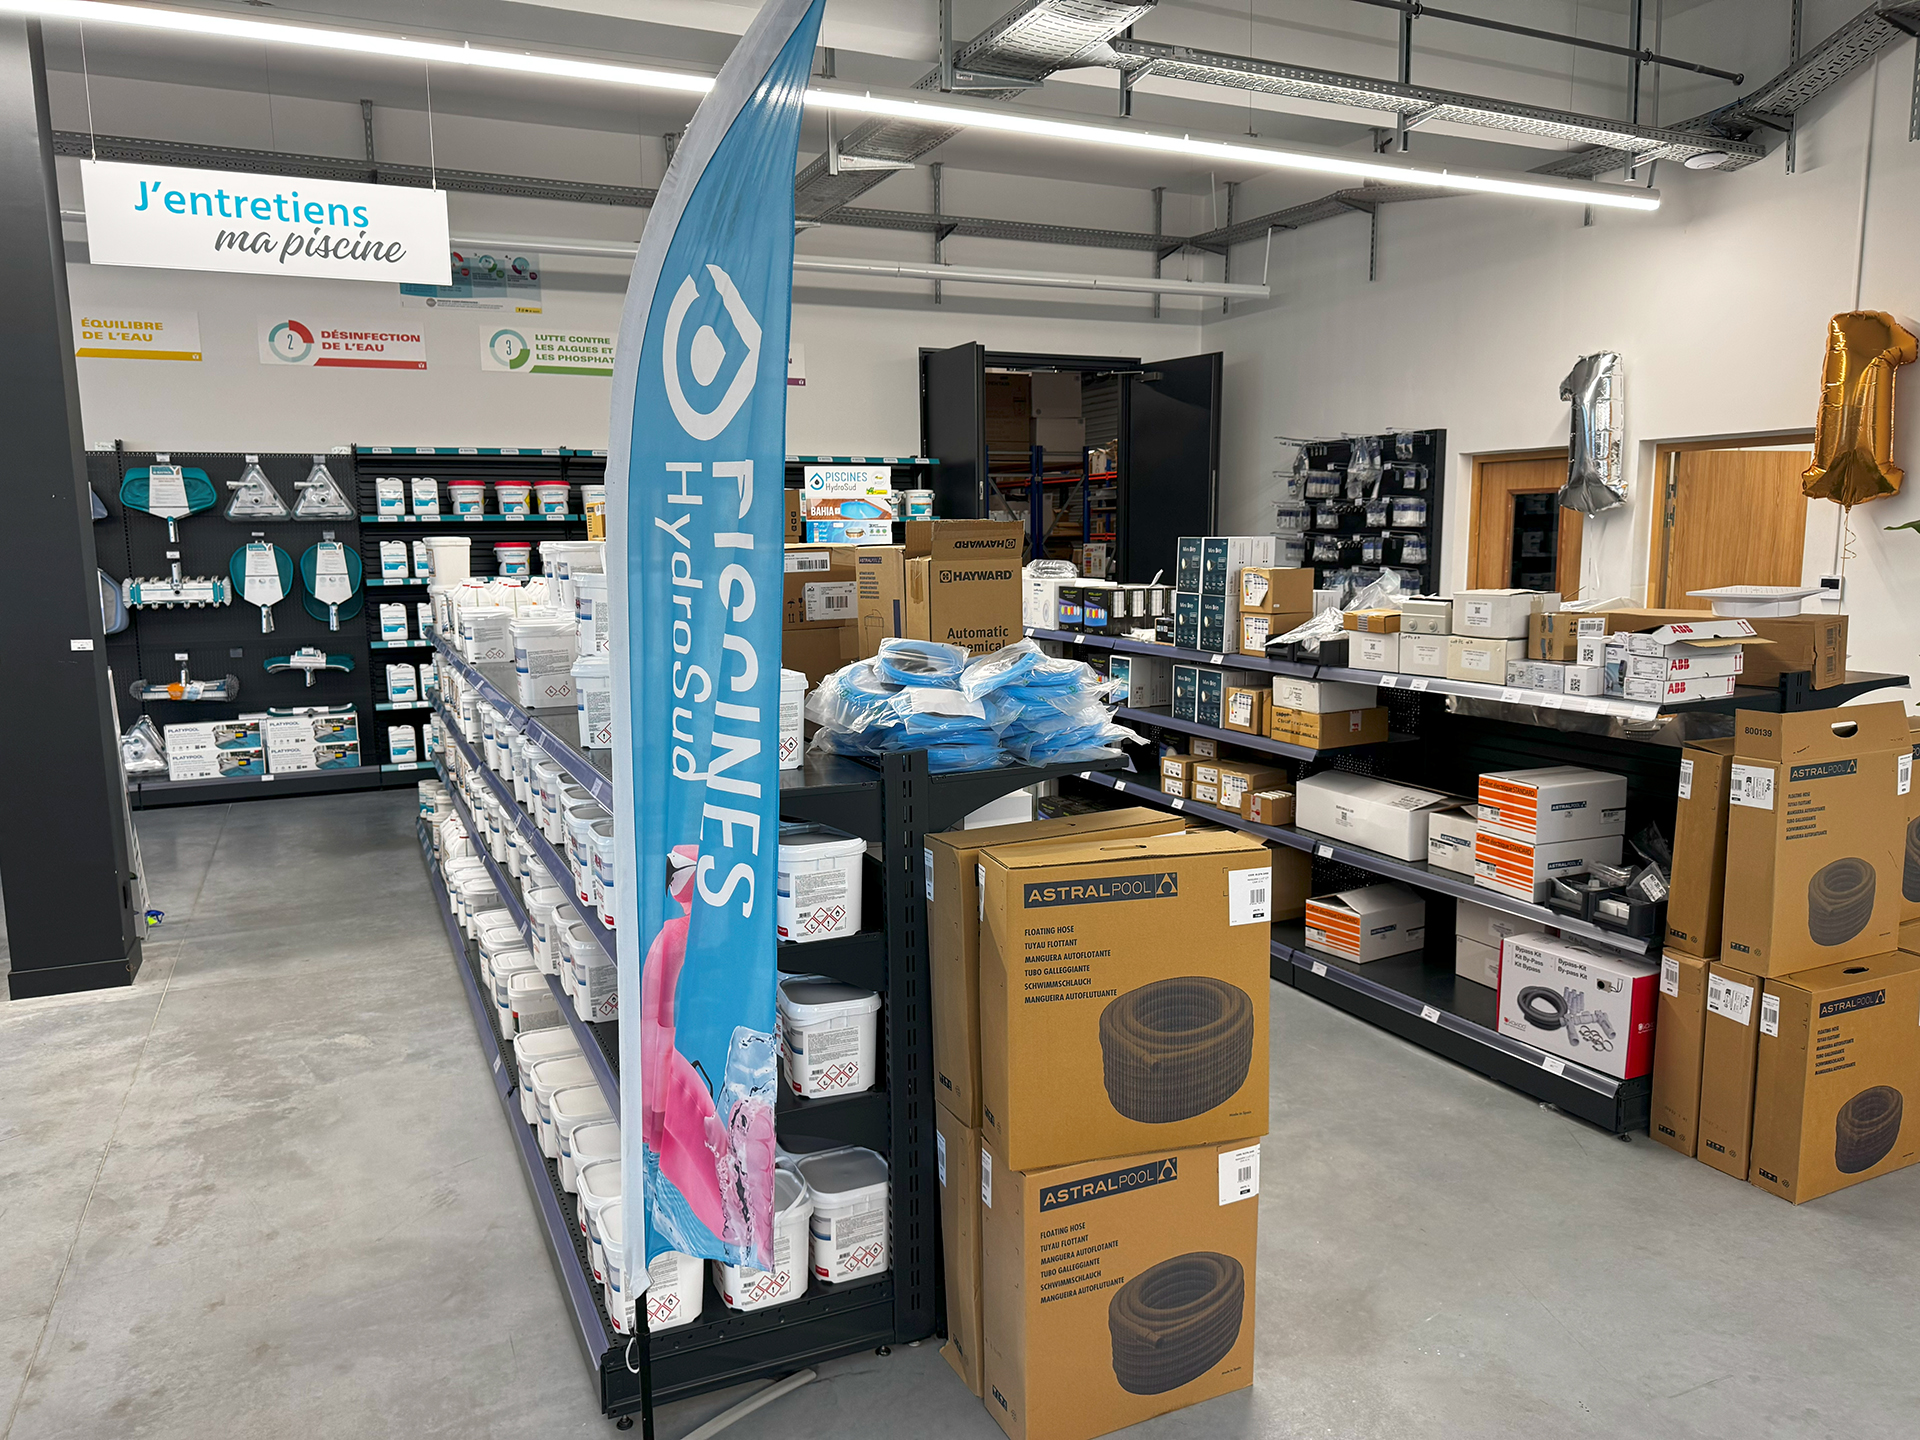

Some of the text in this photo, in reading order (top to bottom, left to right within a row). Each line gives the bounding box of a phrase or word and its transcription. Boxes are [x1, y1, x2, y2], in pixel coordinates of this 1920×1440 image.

[134, 180, 369, 228] J'entretiens
[214, 227, 407, 264] ma piscine
[81, 317, 163, 331] ÉQUILIBRE
[82, 331, 153, 342] DE L'EAU
[288, 334, 294, 350] 2
[321, 329, 421, 342] DÉSINFECTION
[535, 334, 610, 344] LUTTE CONTRE
[322, 342, 384, 352] DE L'EAU
[506, 340, 512, 356] 3
[535, 344, 613, 354] LES ALGUES ET
[536, 353, 554, 361] LES
[825, 472, 868, 482] PISCINES
[825, 483, 857, 493] HydroSud
[810, 506, 834, 516] BAHIA
[954, 540, 1005, 549] HAYWARD
[953, 570, 1012, 581] HAYWARD
[654, 462, 711, 781] HydroSud
[947, 625, 1009, 639] Automatic
[1670, 624, 1694, 634] ABB
[1670, 658, 1690, 671] ABB
[1667, 682, 1686, 695] ABB
[1744, 726, 1773, 738] 800139
[1791, 764, 1846, 779] ASTRALPOOL
[1512, 786, 1535, 797] STANDARD
[1551, 802, 1581, 810] ASTRALPOOL
[1509, 843, 1532, 856] STANDARD
[1028, 880, 1152, 903] ASTRALPOOL
[1024, 925, 1075, 936] FLOATING HOSE
[1024, 939, 1078, 950] TUYAU FLOTTANT
[1515, 945, 1534, 957] Bypass
[1024, 949, 1111, 963] MANGUERA AUTOFLOTANTE
[1522, 955, 1544, 967] By-Pass
[1024, 965, 1090, 977] TUBO GALLEGGIANTE
[1514, 960, 1541, 974] Kit Bypass
[1558, 958, 1587, 972] Bypass-Kit
[1557, 966, 1588, 980] By-pass Kit
[1024, 978, 1092, 991] SCHWIMMSCHLAUCH
[1024, 989, 1117, 1004] MANGUEIRA AUTOFLUTUANTE
[1821, 996, 1874, 1015] ASTRALPOOL
[1043, 1169, 1154, 1206] ASTRALPOOL
[1040, 1222, 1086, 1239] FLOATING HOSE
[1040, 1235, 1089, 1253] TUYAU FLOTTANT
[1040, 1240, 1119, 1266] MANGUERA AUTOFLOTANTE
[1040, 1258, 1100, 1278] TUBO GALLEGGIANTE
[1040, 1270, 1102, 1292] SCHWIMMSCHLAUCH
[1040, 1276, 1125, 1304] MANGUEIRA AUTOFLUTUANTE
